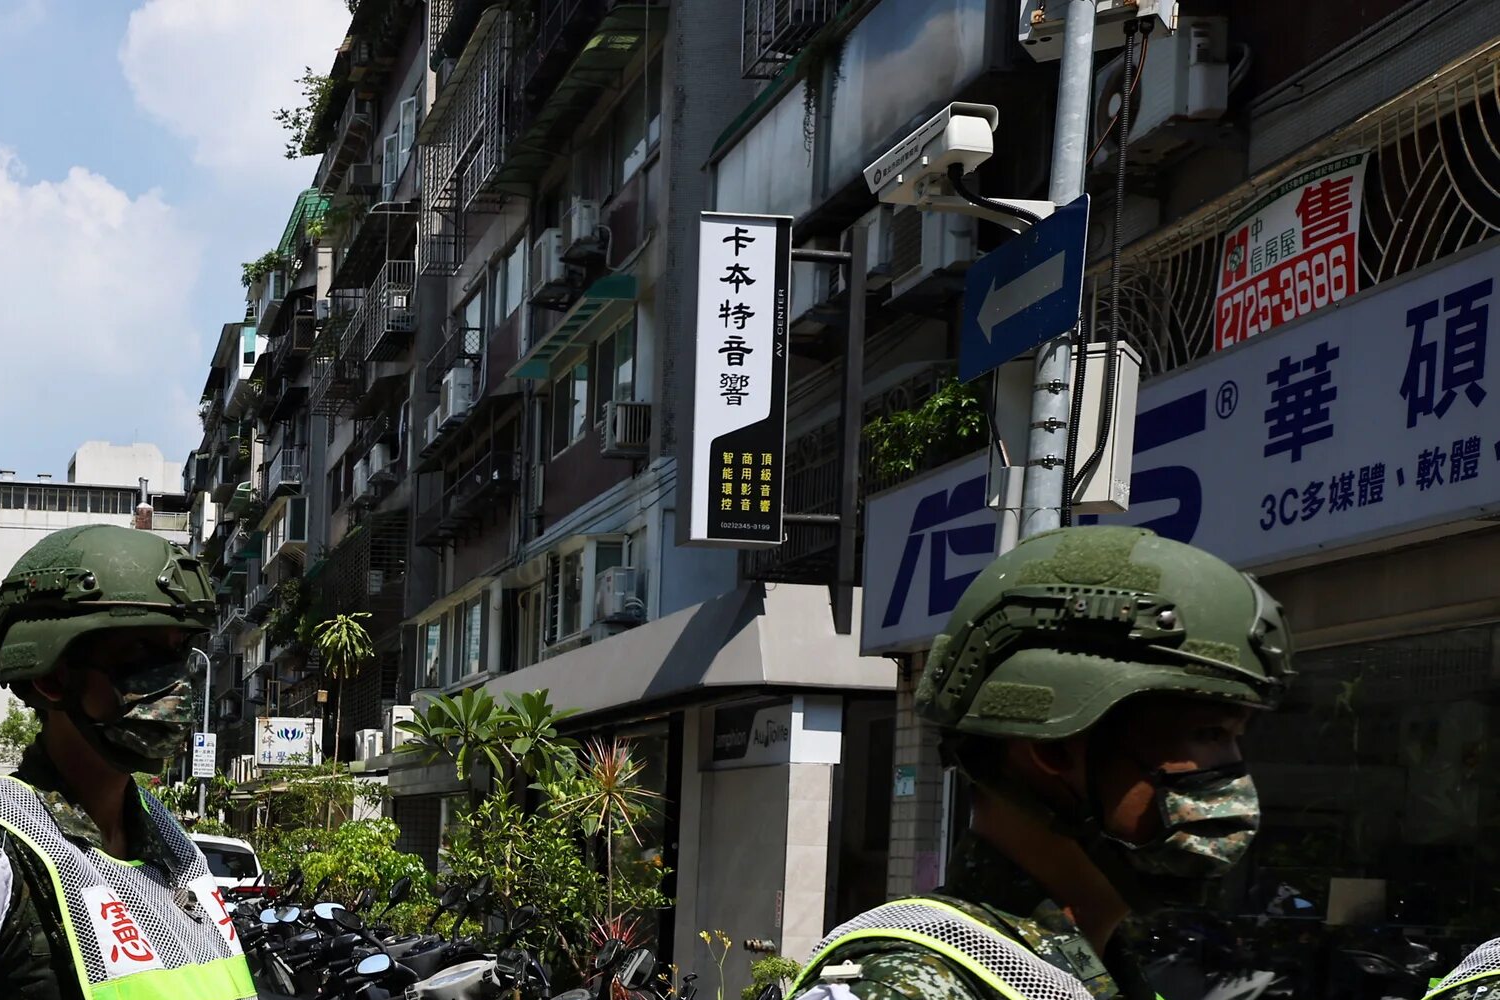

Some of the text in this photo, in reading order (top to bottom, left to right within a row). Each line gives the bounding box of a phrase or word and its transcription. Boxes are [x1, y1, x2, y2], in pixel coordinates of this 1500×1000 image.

[1295, 175, 1354, 250] 售
[717, 226, 757, 406] 卡本特音響
[776, 288, 785, 358] AV CENTER
[1221, 244, 1348, 350] 2725-3686
[1263, 277, 1494, 464] 華碩
[720, 451, 734, 511] 智能環控
[740, 452, 753, 512] 商用影音
[760, 453, 773, 513] 頂級音響
[100, 892, 155, 963] 憲
